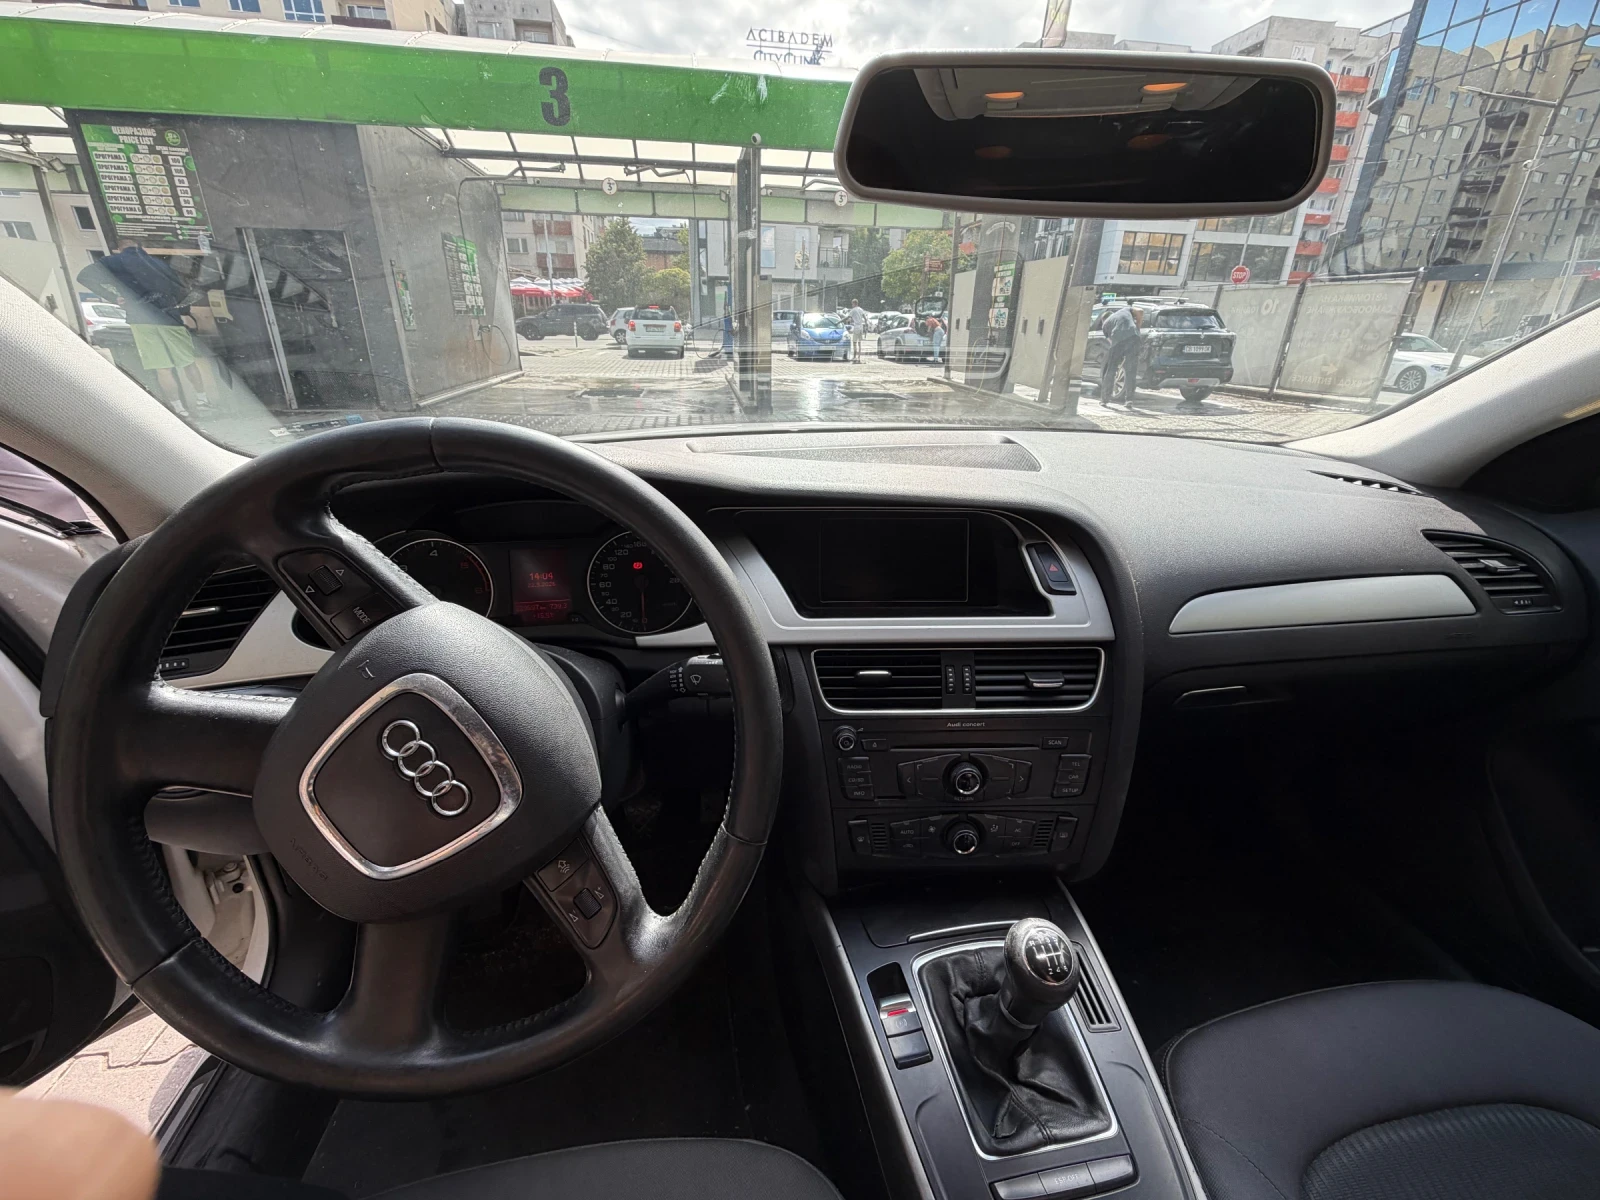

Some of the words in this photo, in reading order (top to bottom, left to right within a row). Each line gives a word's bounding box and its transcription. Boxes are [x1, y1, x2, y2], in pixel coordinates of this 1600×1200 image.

[746, 27, 833, 48] ACIBADEM
[538, 67, 571, 127] 3
[118, 135, 140, 144] PRICE
[139, 136, 154, 145] LIST
[1232, 271, 1247, 279] STOP
[429, 549, 438, 557] 4
[529, 572, 554, 581] 14:04
[352, 606, 372, 625] MODE
[1054, 1176, 1066, 1185] ESP
[1067, 1173, 1078, 1182] OFF
